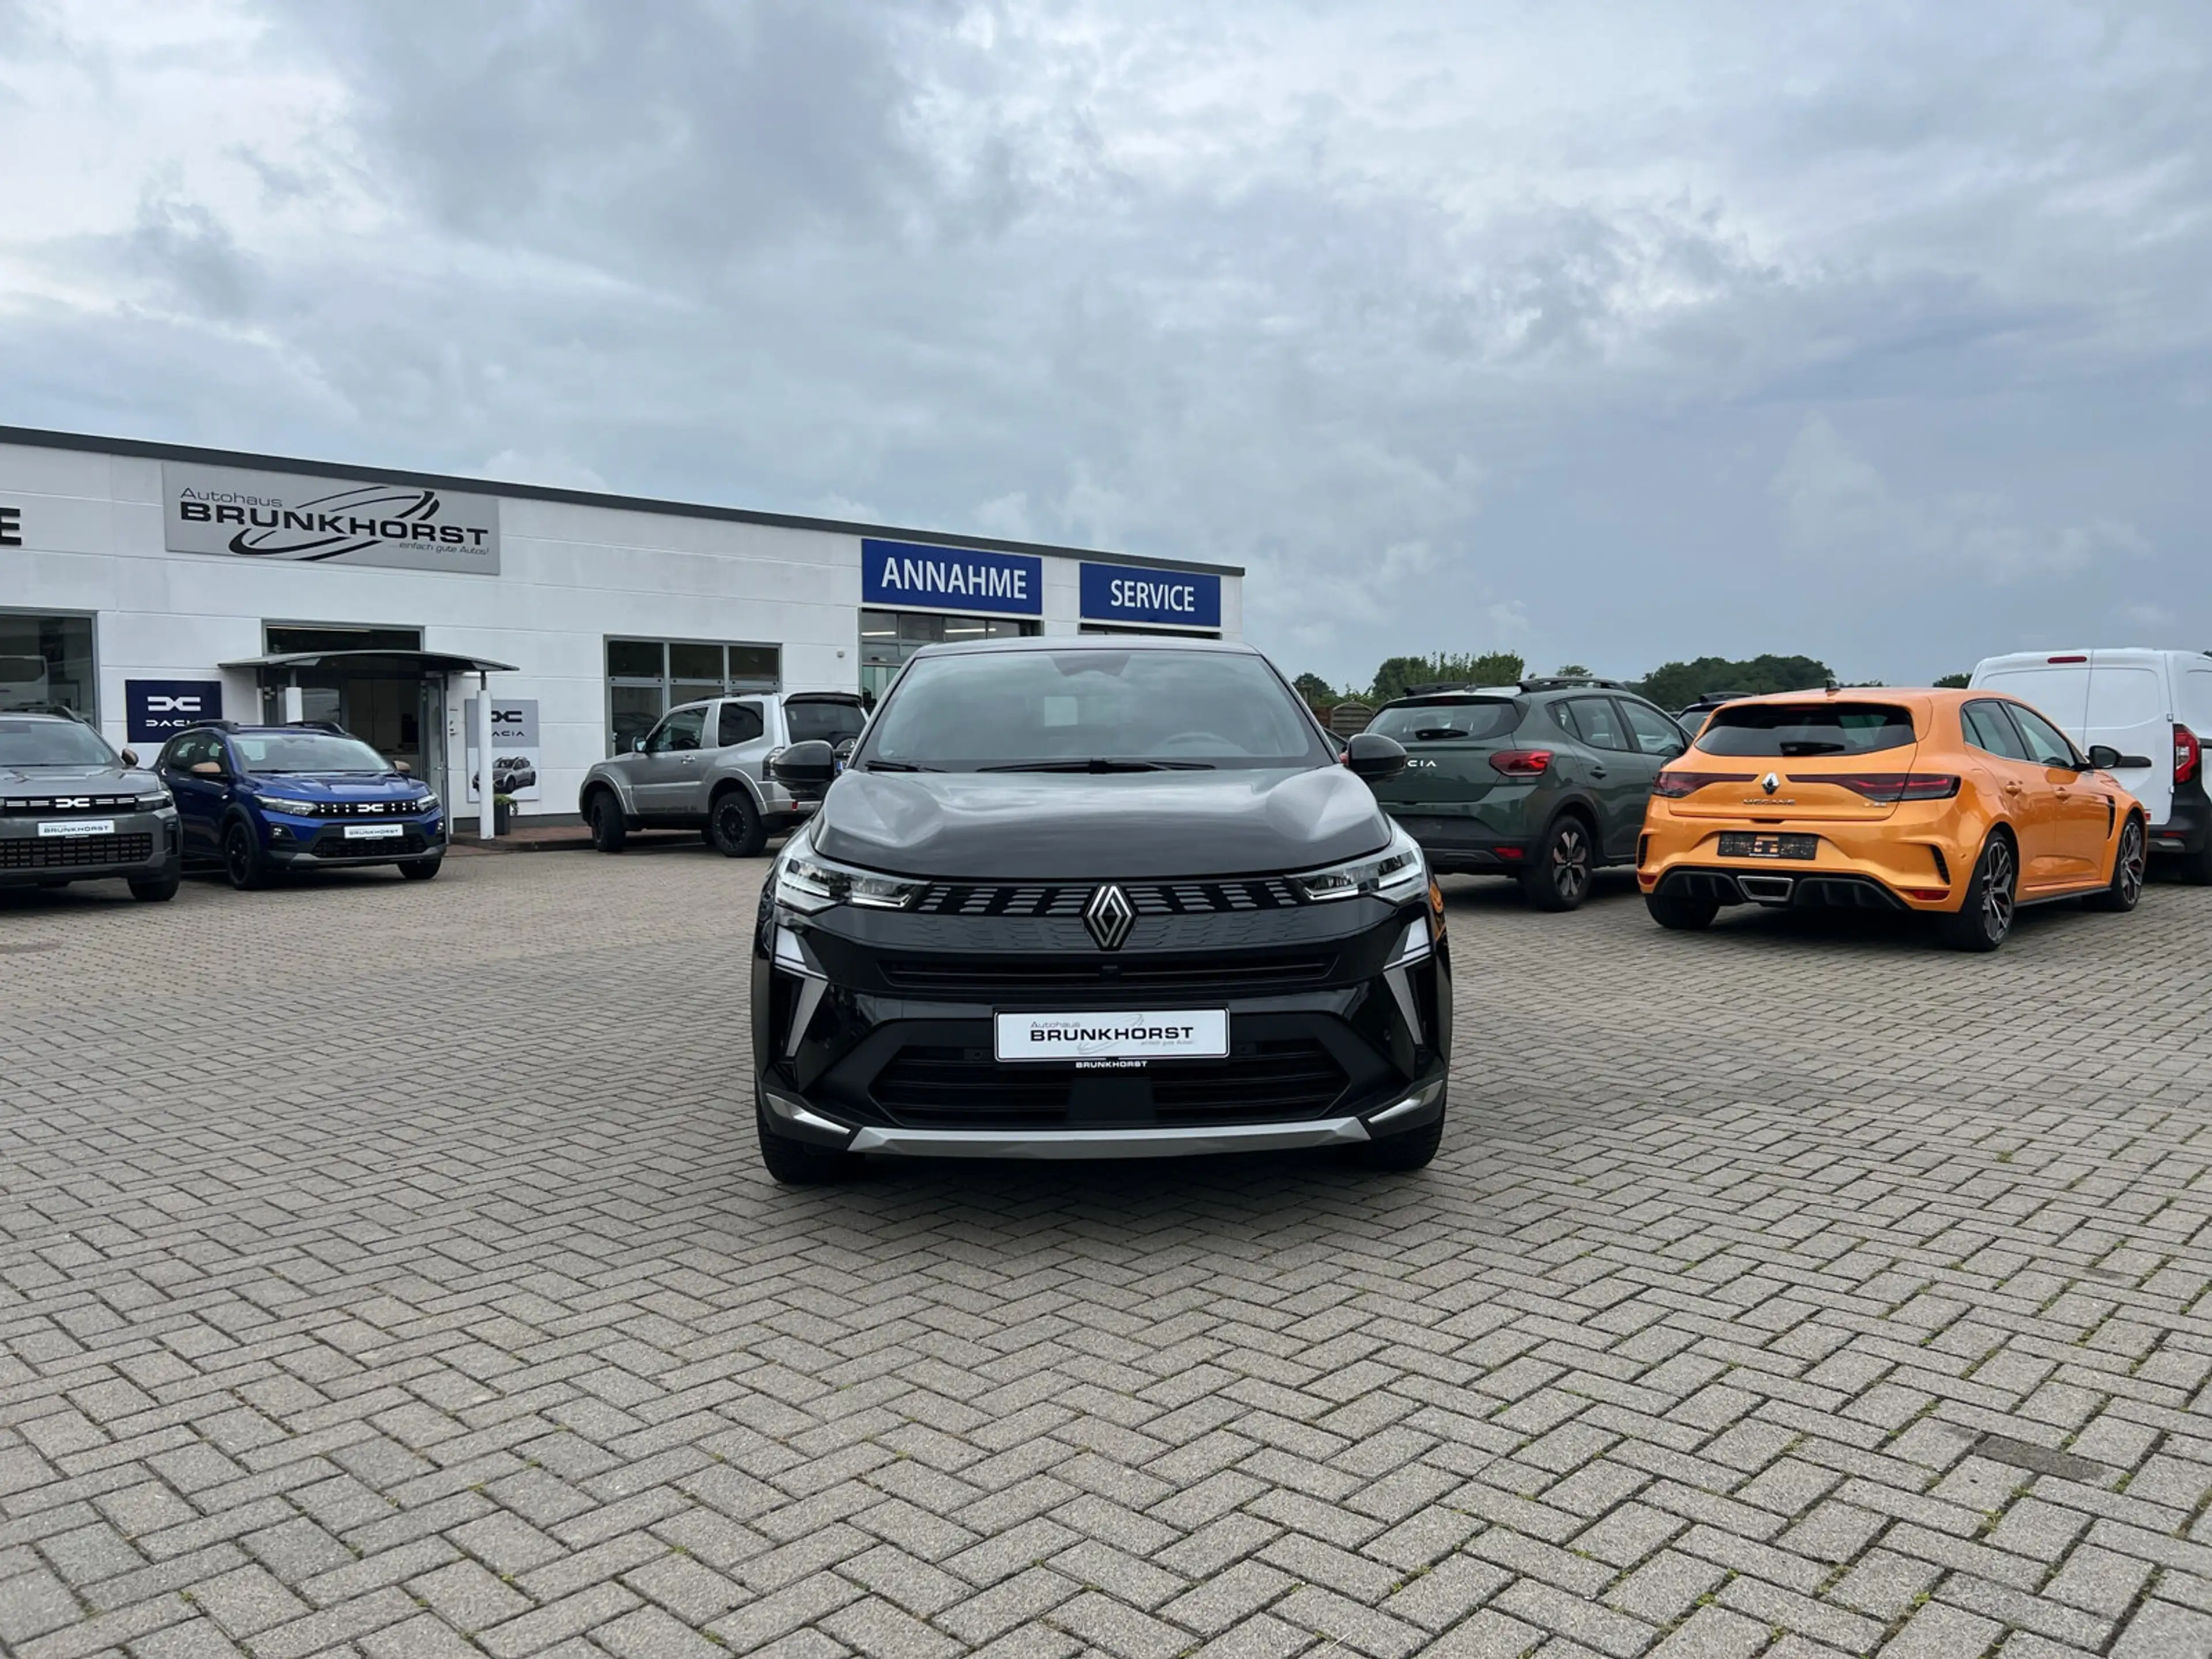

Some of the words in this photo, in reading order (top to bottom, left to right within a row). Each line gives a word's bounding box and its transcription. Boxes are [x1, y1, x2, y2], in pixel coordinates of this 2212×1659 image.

[180, 487, 283, 507] Autohaus
[180, 501, 488, 545] BRUNKHORST
[881, 557, 1027, 600] ANNAHME
[1110, 579, 1195, 612] SERVICE
[1407, 759, 1437, 767] CIA
[1031, 1027, 1194, 1041] BRUNKHORST
